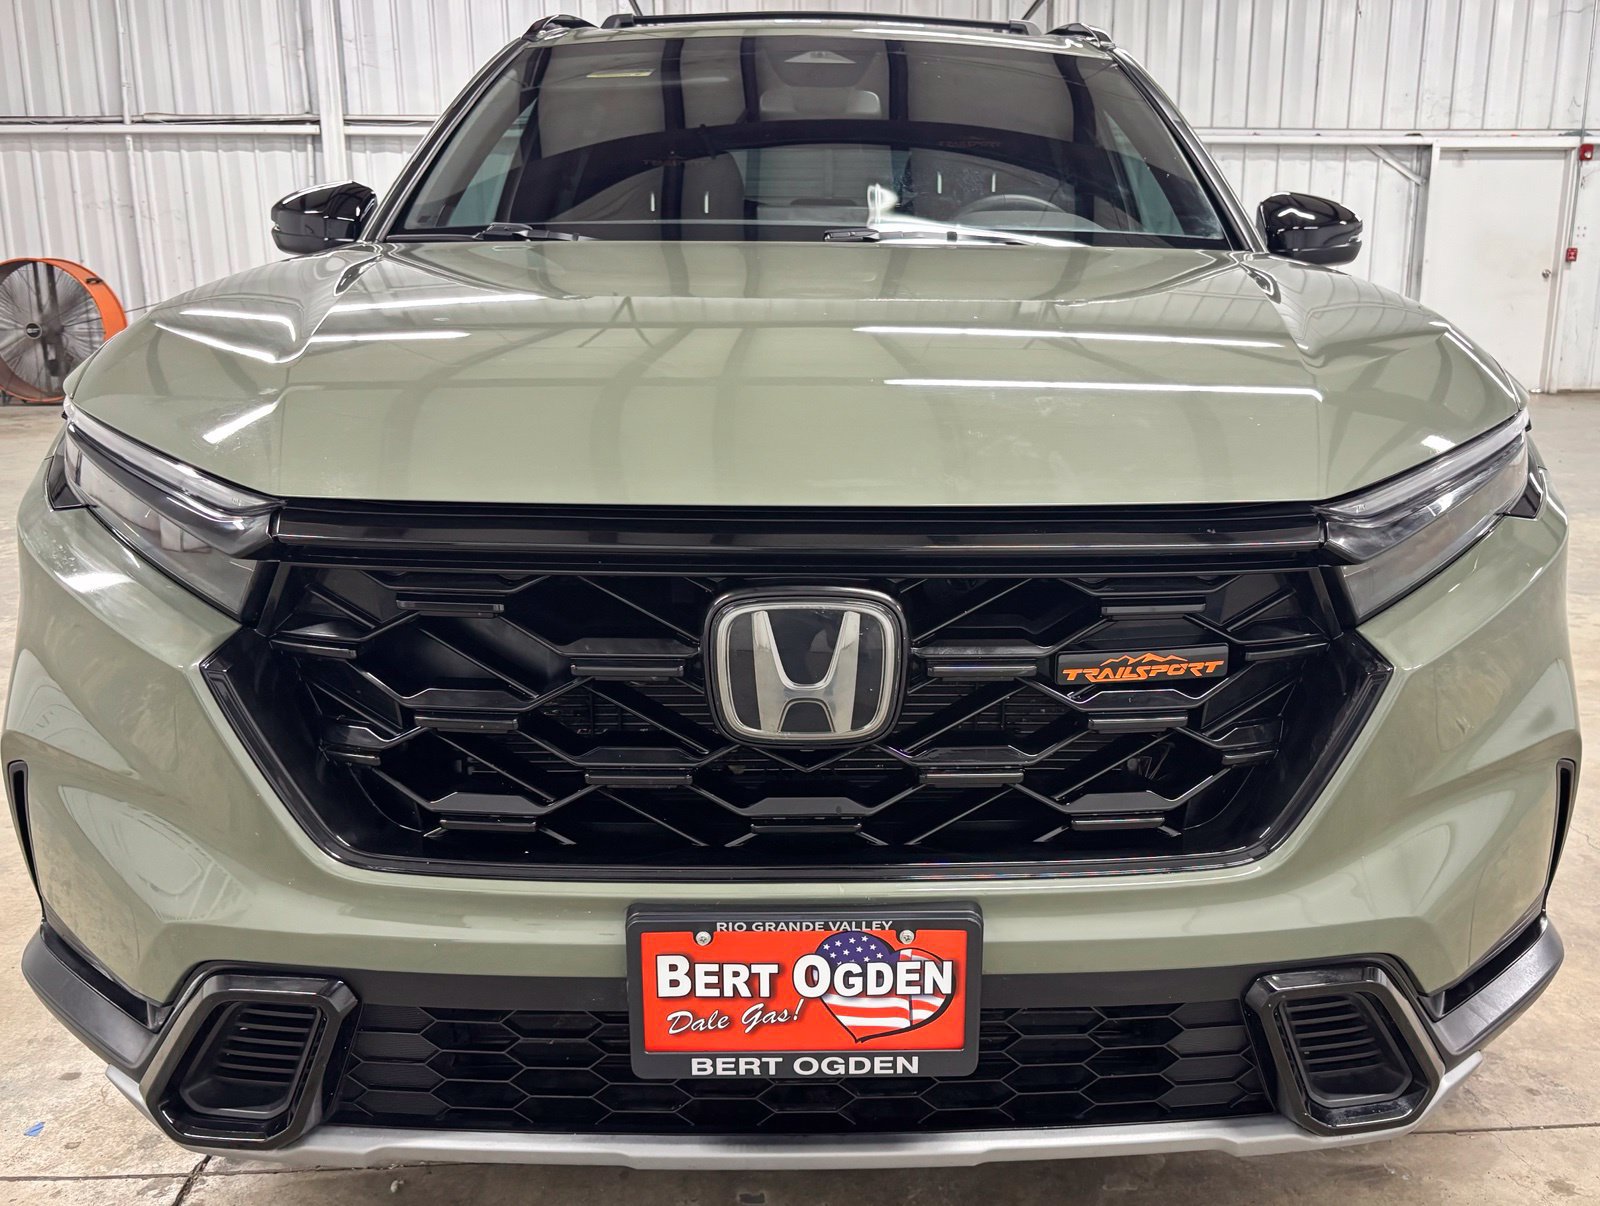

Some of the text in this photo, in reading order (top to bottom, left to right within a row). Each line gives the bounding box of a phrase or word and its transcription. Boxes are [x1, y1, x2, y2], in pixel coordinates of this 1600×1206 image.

[1062, 660, 1225, 683] TRAILSPORT
[716, 920, 893, 932] RIO GRANDE VALLEY
[655, 953, 953, 999] BERT OGDEN
[667, 998, 805, 1036] Dale Gas!
[691, 1056, 919, 1077] BERT OGDEN
